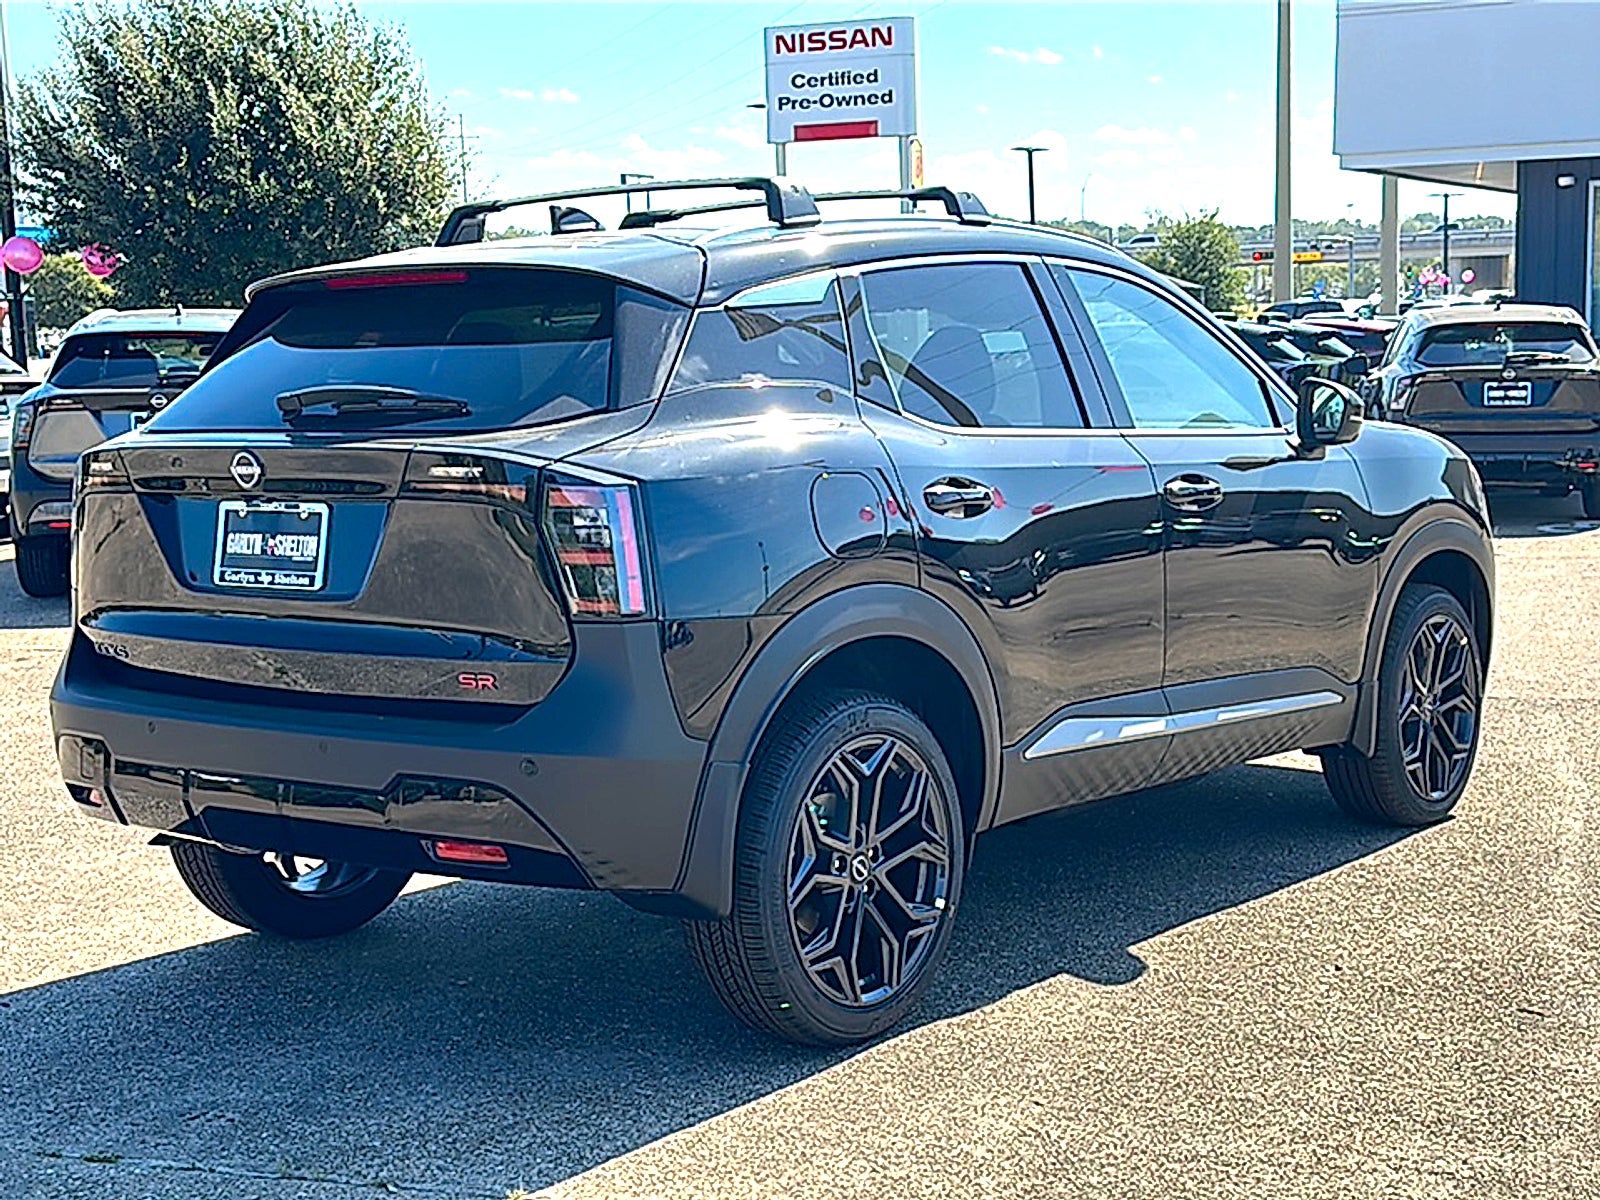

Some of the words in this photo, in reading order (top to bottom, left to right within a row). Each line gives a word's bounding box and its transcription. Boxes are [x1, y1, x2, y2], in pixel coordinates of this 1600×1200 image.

[775, 26, 893, 54] NISSAN
[791, 68, 879, 89] Certified
[777, 89, 893, 111] Pre-Owned
[274, 534, 318, 557] SHELTON
[457, 672, 498, 690] SR
